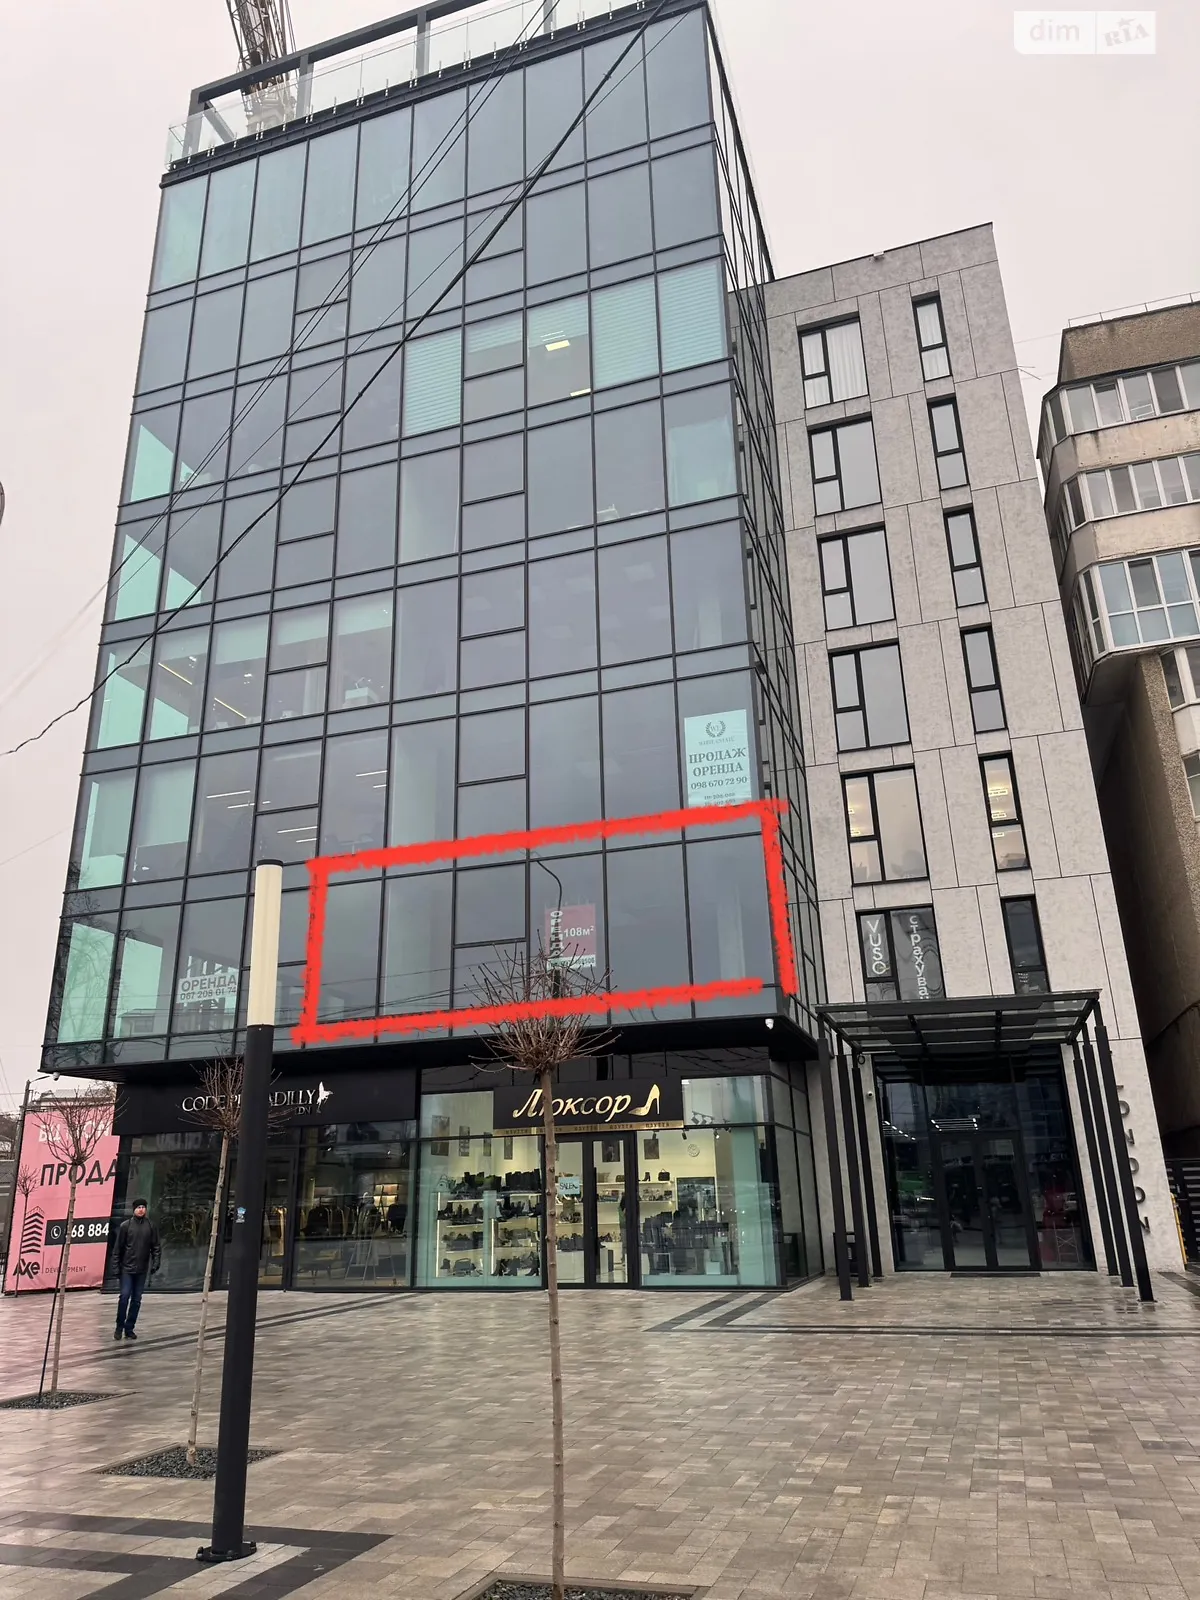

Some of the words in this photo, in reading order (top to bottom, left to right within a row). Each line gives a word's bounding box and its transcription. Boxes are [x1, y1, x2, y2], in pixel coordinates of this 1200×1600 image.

[689, 747, 747, 764] ПРОДАЖ
[692, 762, 744, 777] ОРЕНДА
[690, 781, 707, 790] 098
[708, 779, 724, 788] 670
[725, 777, 735, 786] 72
[736, 776, 748, 784] 90
[909, 915, 930, 1000] страхува
[181, 975, 237, 992] ОРЕНДА
[182, 1095, 226, 1112] CODE
[65, 1225, 85, 1238] 68
[87, 1222, 110, 1237] 884
